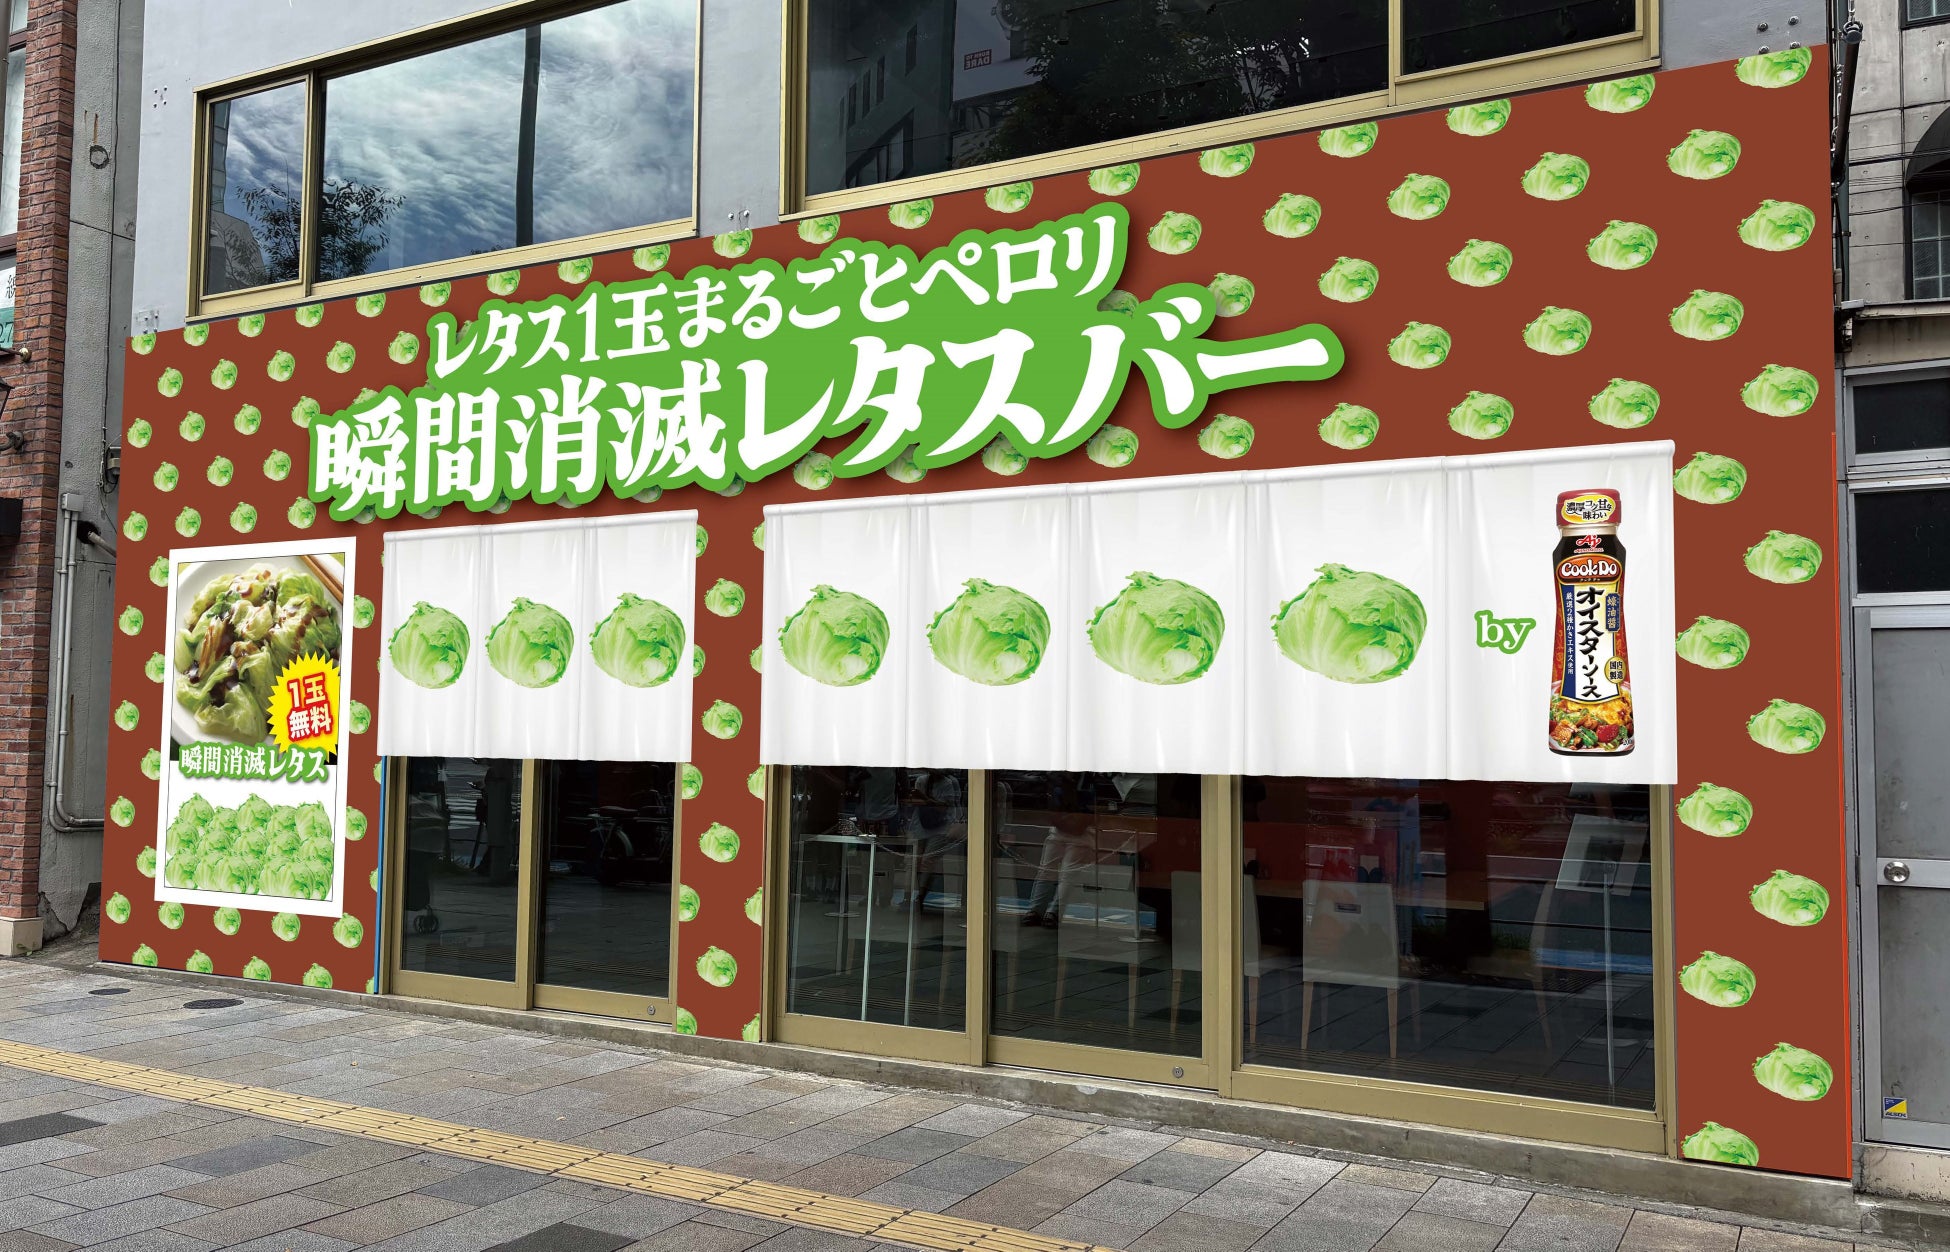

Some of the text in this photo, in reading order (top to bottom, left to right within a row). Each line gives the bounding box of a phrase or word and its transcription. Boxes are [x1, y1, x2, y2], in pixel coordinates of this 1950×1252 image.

[434, 215, 1116, 379] レタス1玉まるごとペロリ
[315, 297, 1329, 512] 瞬間消滅レタスバー
[1479, 614, 1532, 650] by
[1576, 586, 1605, 698] オイスターソース
[288, 675, 326, 708] 1玉
[288, 704, 332, 739] 無料
[181, 745, 326, 778] 瞬間消滅レタス
